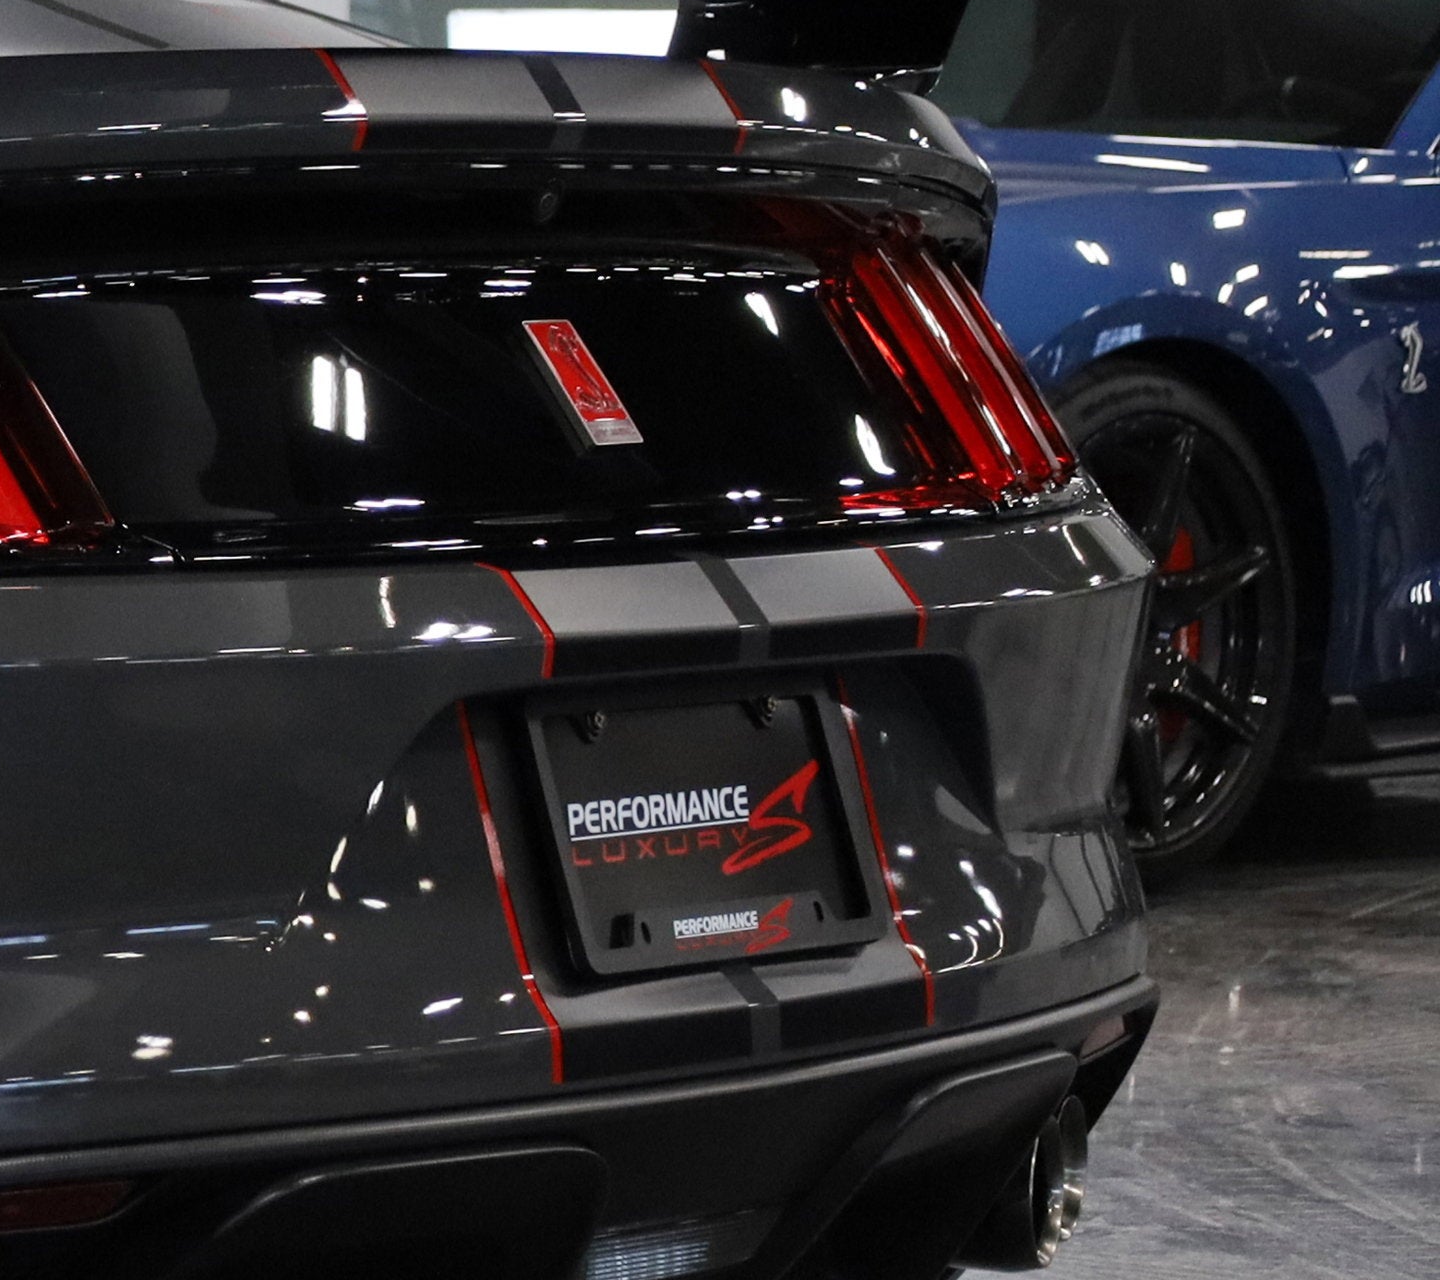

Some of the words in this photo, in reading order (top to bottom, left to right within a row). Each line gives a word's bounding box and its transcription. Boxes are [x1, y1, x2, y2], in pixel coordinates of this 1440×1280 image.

[567, 785, 749, 836] PERFORMANCE
[573, 826, 749, 866] LUXURY
[673, 910, 759, 937] PERFORMANCE
